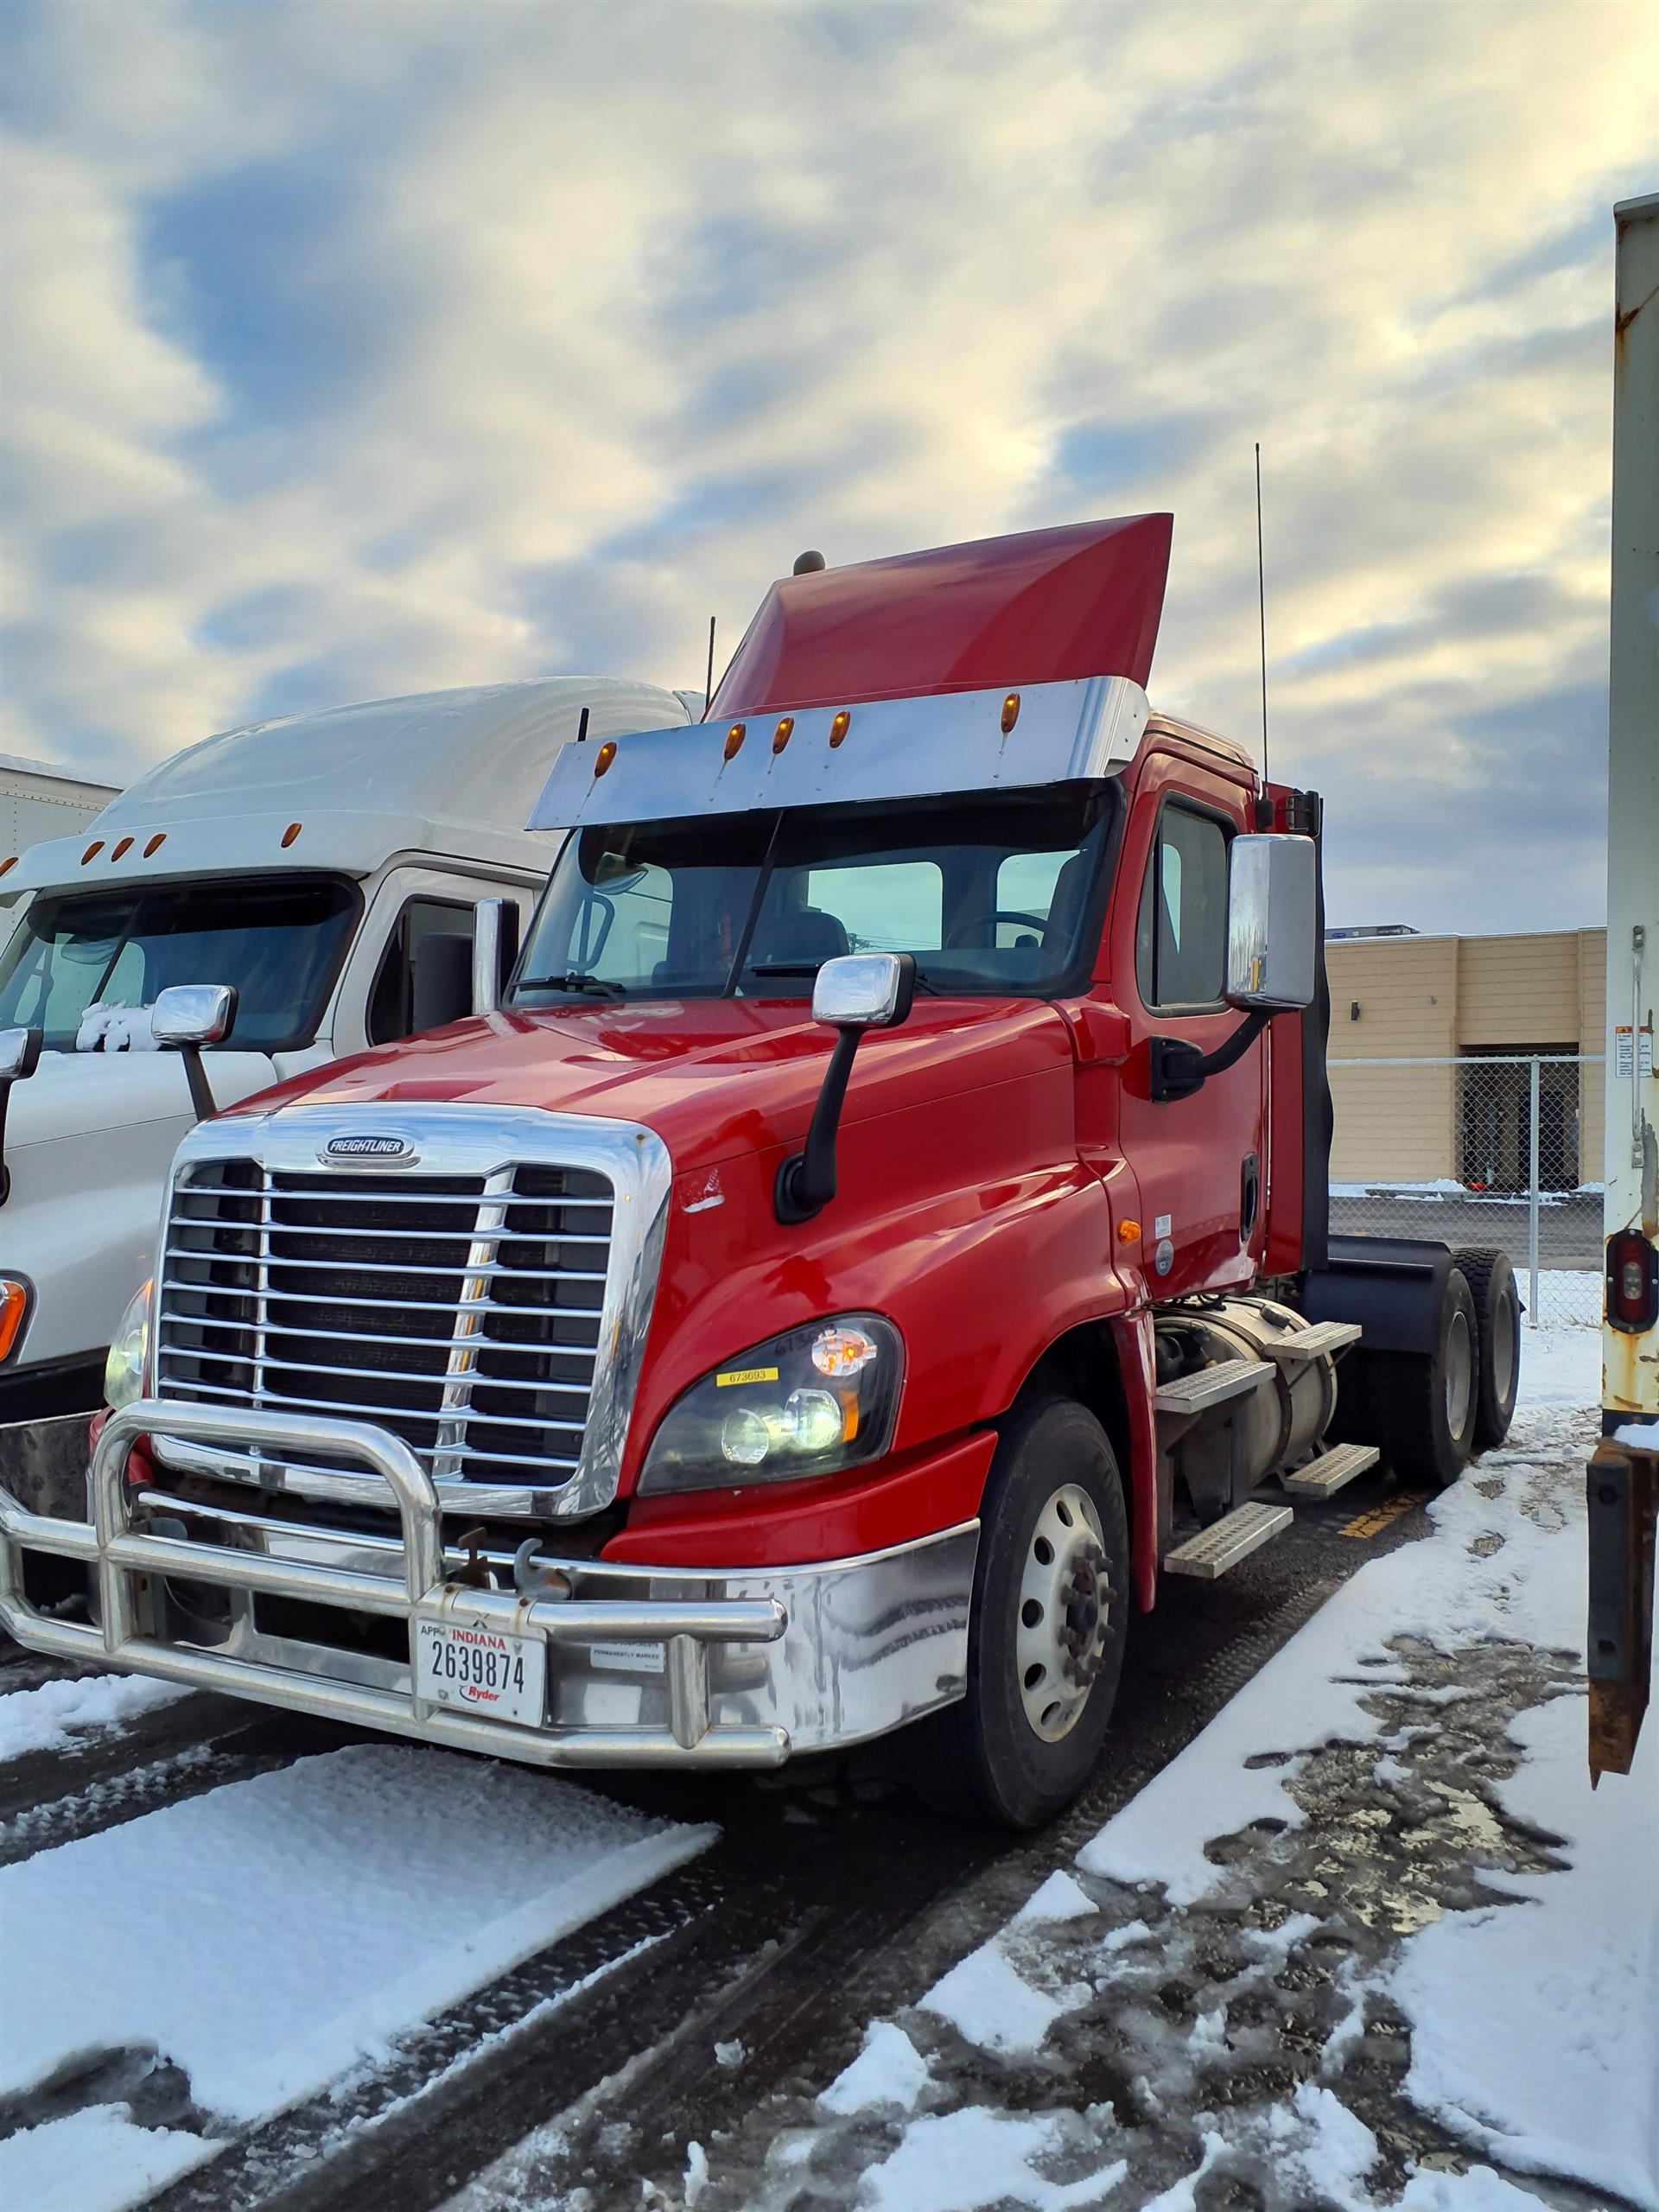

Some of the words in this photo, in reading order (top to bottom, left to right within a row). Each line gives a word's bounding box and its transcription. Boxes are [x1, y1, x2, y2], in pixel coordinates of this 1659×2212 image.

[330, 1140, 402, 1152] FREIGHTLINER
[729, 1370, 766, 1382] 673693
[452, 1629, 506, 1651] INDIANA
[432, 1640, 524, 1694] 2639874
[468, 1686, 499, 1701] Ryder
